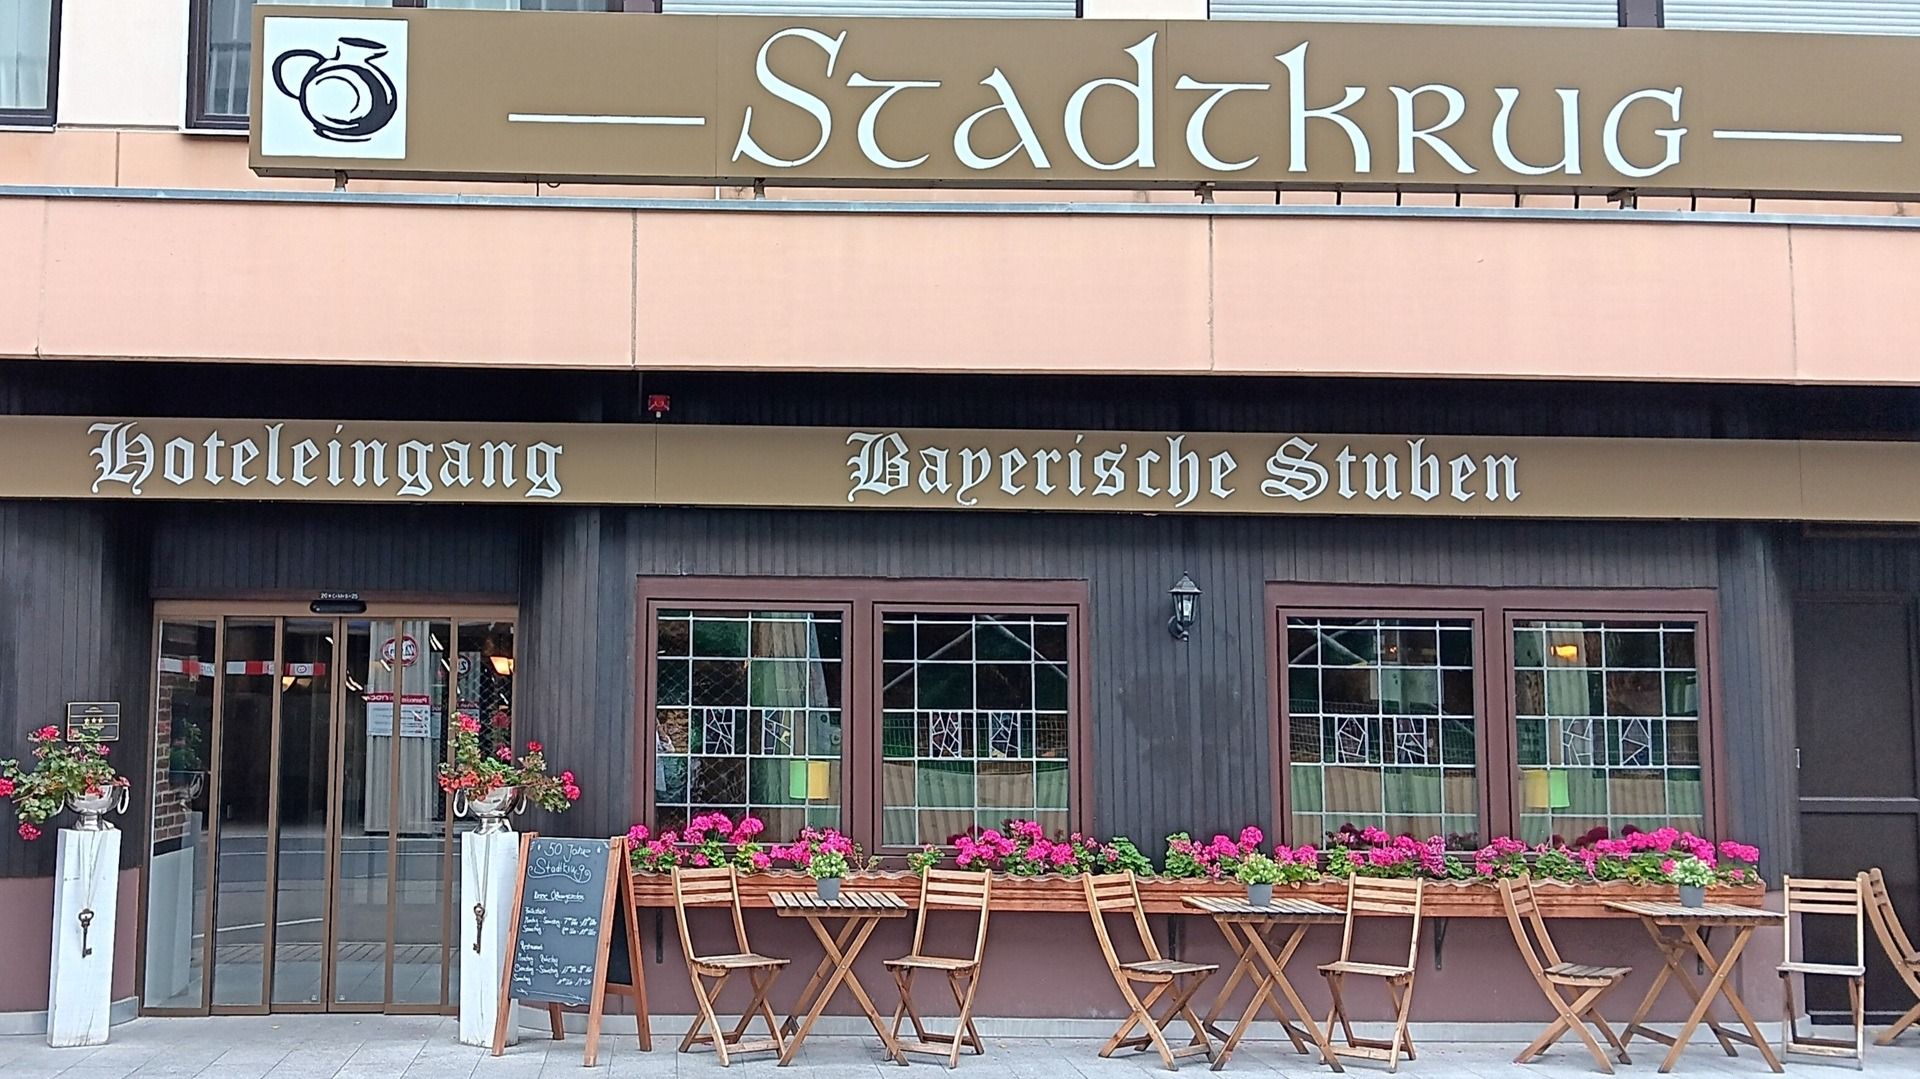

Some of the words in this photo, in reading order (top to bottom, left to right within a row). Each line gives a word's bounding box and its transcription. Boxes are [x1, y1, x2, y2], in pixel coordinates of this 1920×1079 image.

[86, 422, 563, 498] Hoteleingang
[846, 431, 1239, 508] Bayerische
[1259, 436, 1521, 502] Stuben
[533, 857, 586, 883] Stadtkrug
[544, 842, 562, 857] 50
[563, 844, 591, 863] Jahre
